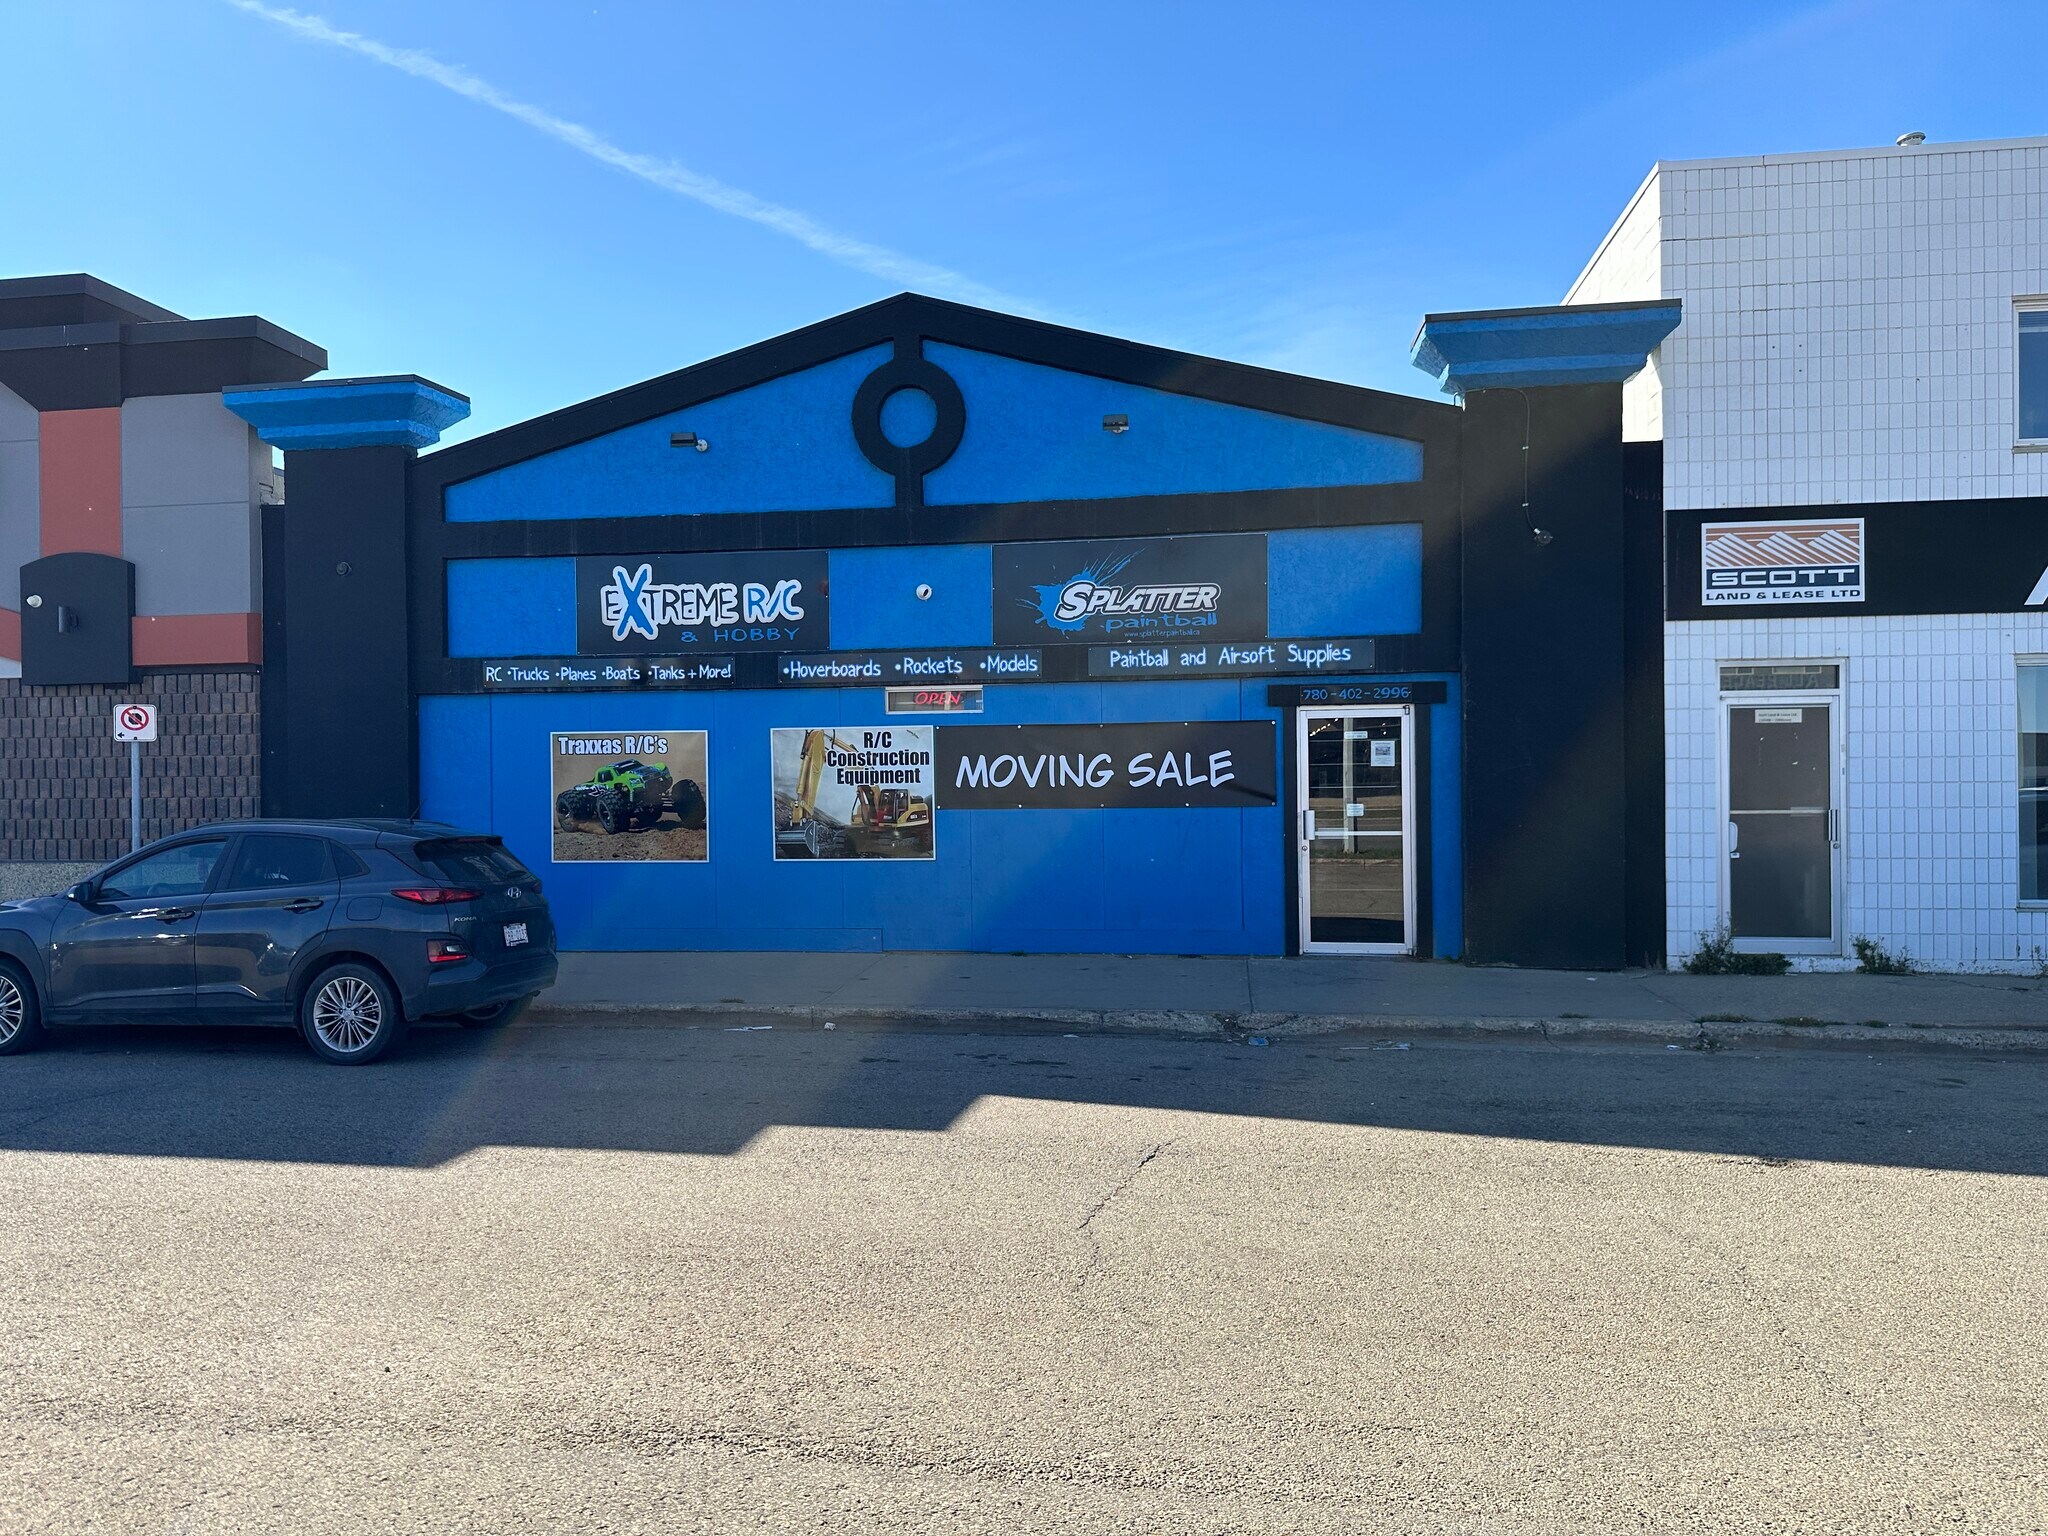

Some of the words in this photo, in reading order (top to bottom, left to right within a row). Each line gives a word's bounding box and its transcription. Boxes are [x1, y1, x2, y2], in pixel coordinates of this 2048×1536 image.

[1711, 568, 1855, 586] SCOTT
[602, 564, 739, 641] EXTREME
[743, 579, 804, 623] R/C
[1054, 580, 1221, 622] SPLATTER
[1706, 592, 1751, 601] LAND
[1772, 590, 1824, 599] LEASE
[1831, 589, 1861, 598] LTD
[1105, 612, 1218, 633] paintball
[681, 631, 698, 642] &
[714, 627, 800, 642] HOBBY
[1110, 648, 1169, 667] Paintball
[1180, 647, 1206, 666] and
[1218, 646, 1276, 665] Airsoft
[1287, 643, 1351, 668] Supplies
[486, 667, 502, 682] RC
[699, 664, 732, 679] More!
[914, 691, 962, 705] OPEN
[558, 736, 622, 755] Traxxas
[625, 735, 668, 754] R/C's
[863, 731, 892, 749] R/C
[827, 750, 930, 767] Construction
[836, 768, 921, 786] Equipment
[955, 753, 1114, 788] MOVING
[1127, 750, 1235, 788] SALE
